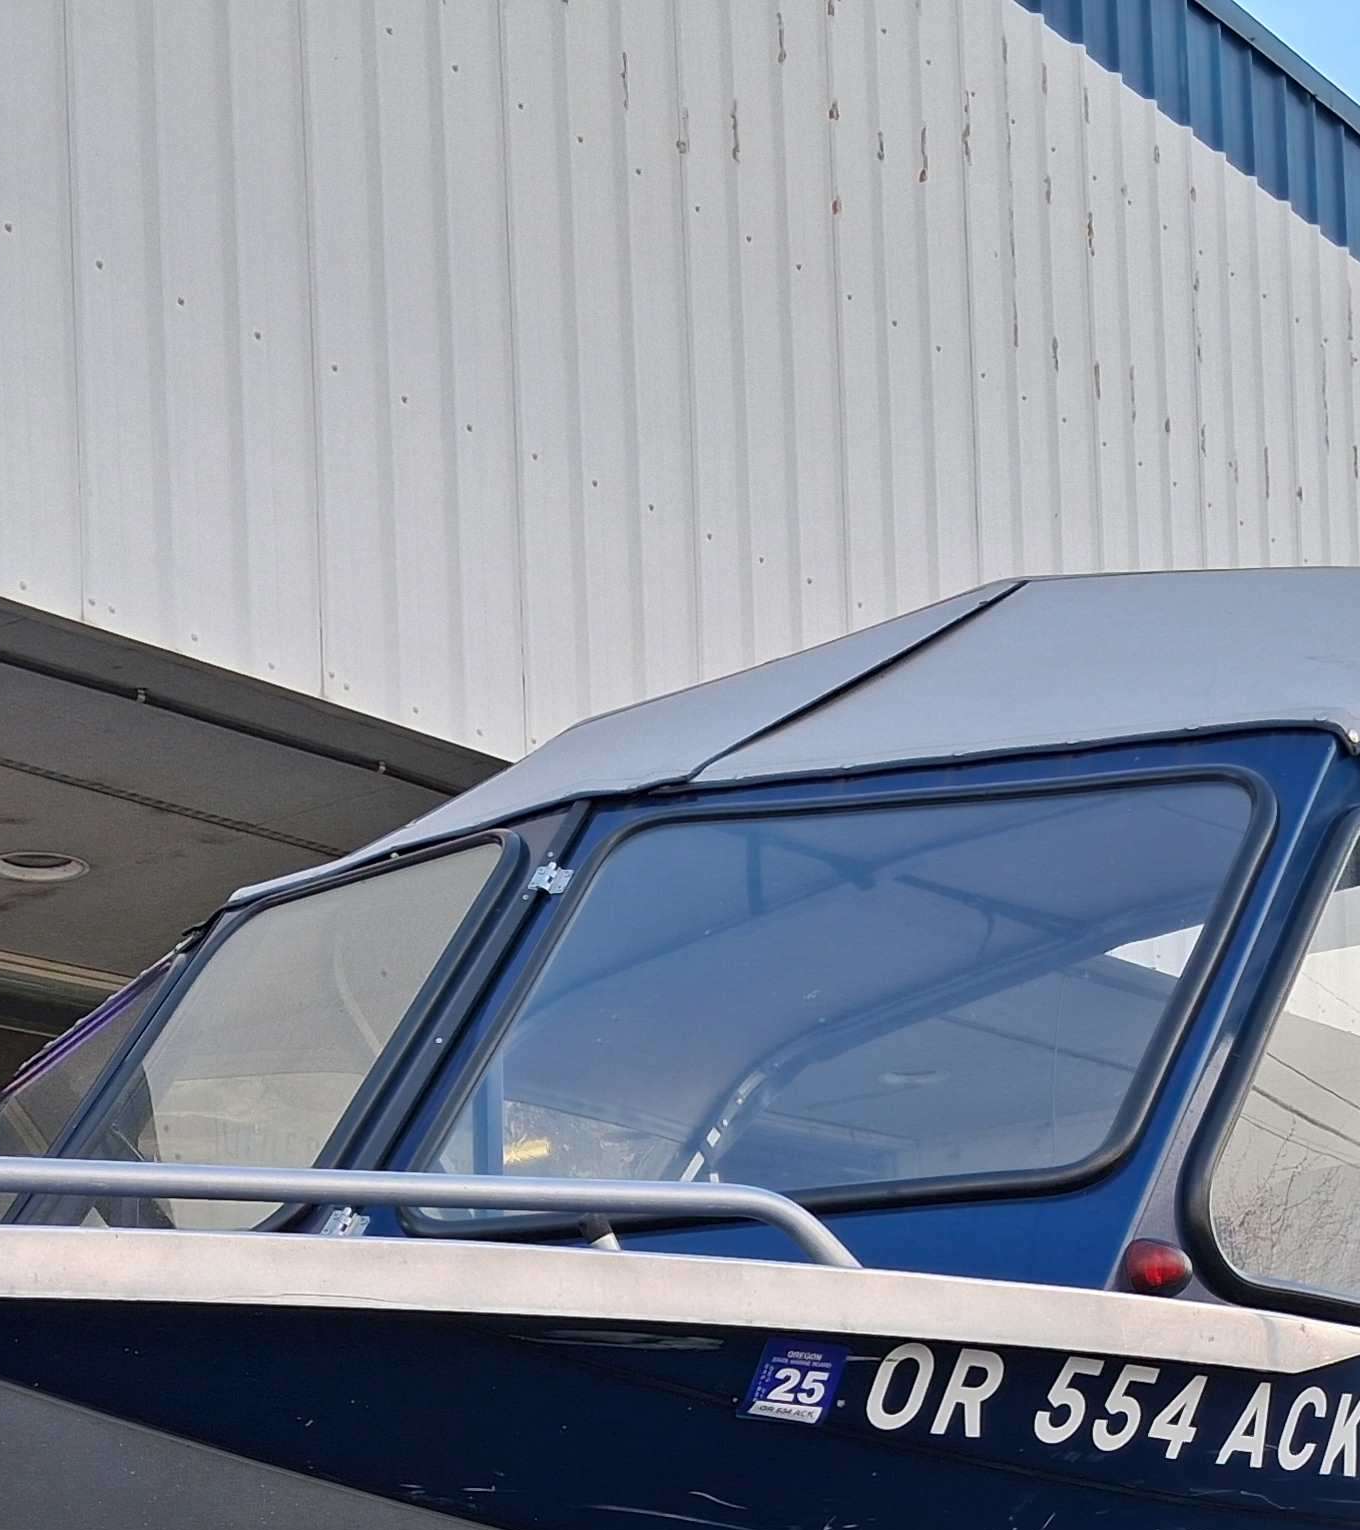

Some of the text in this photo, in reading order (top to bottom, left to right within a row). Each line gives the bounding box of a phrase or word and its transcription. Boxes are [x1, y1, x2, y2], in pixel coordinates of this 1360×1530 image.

[767, 1367, 830, 1404] 25
[865, 1342, 1005, 1438] OR
[1033, 1356, 1207, 1460] 554
